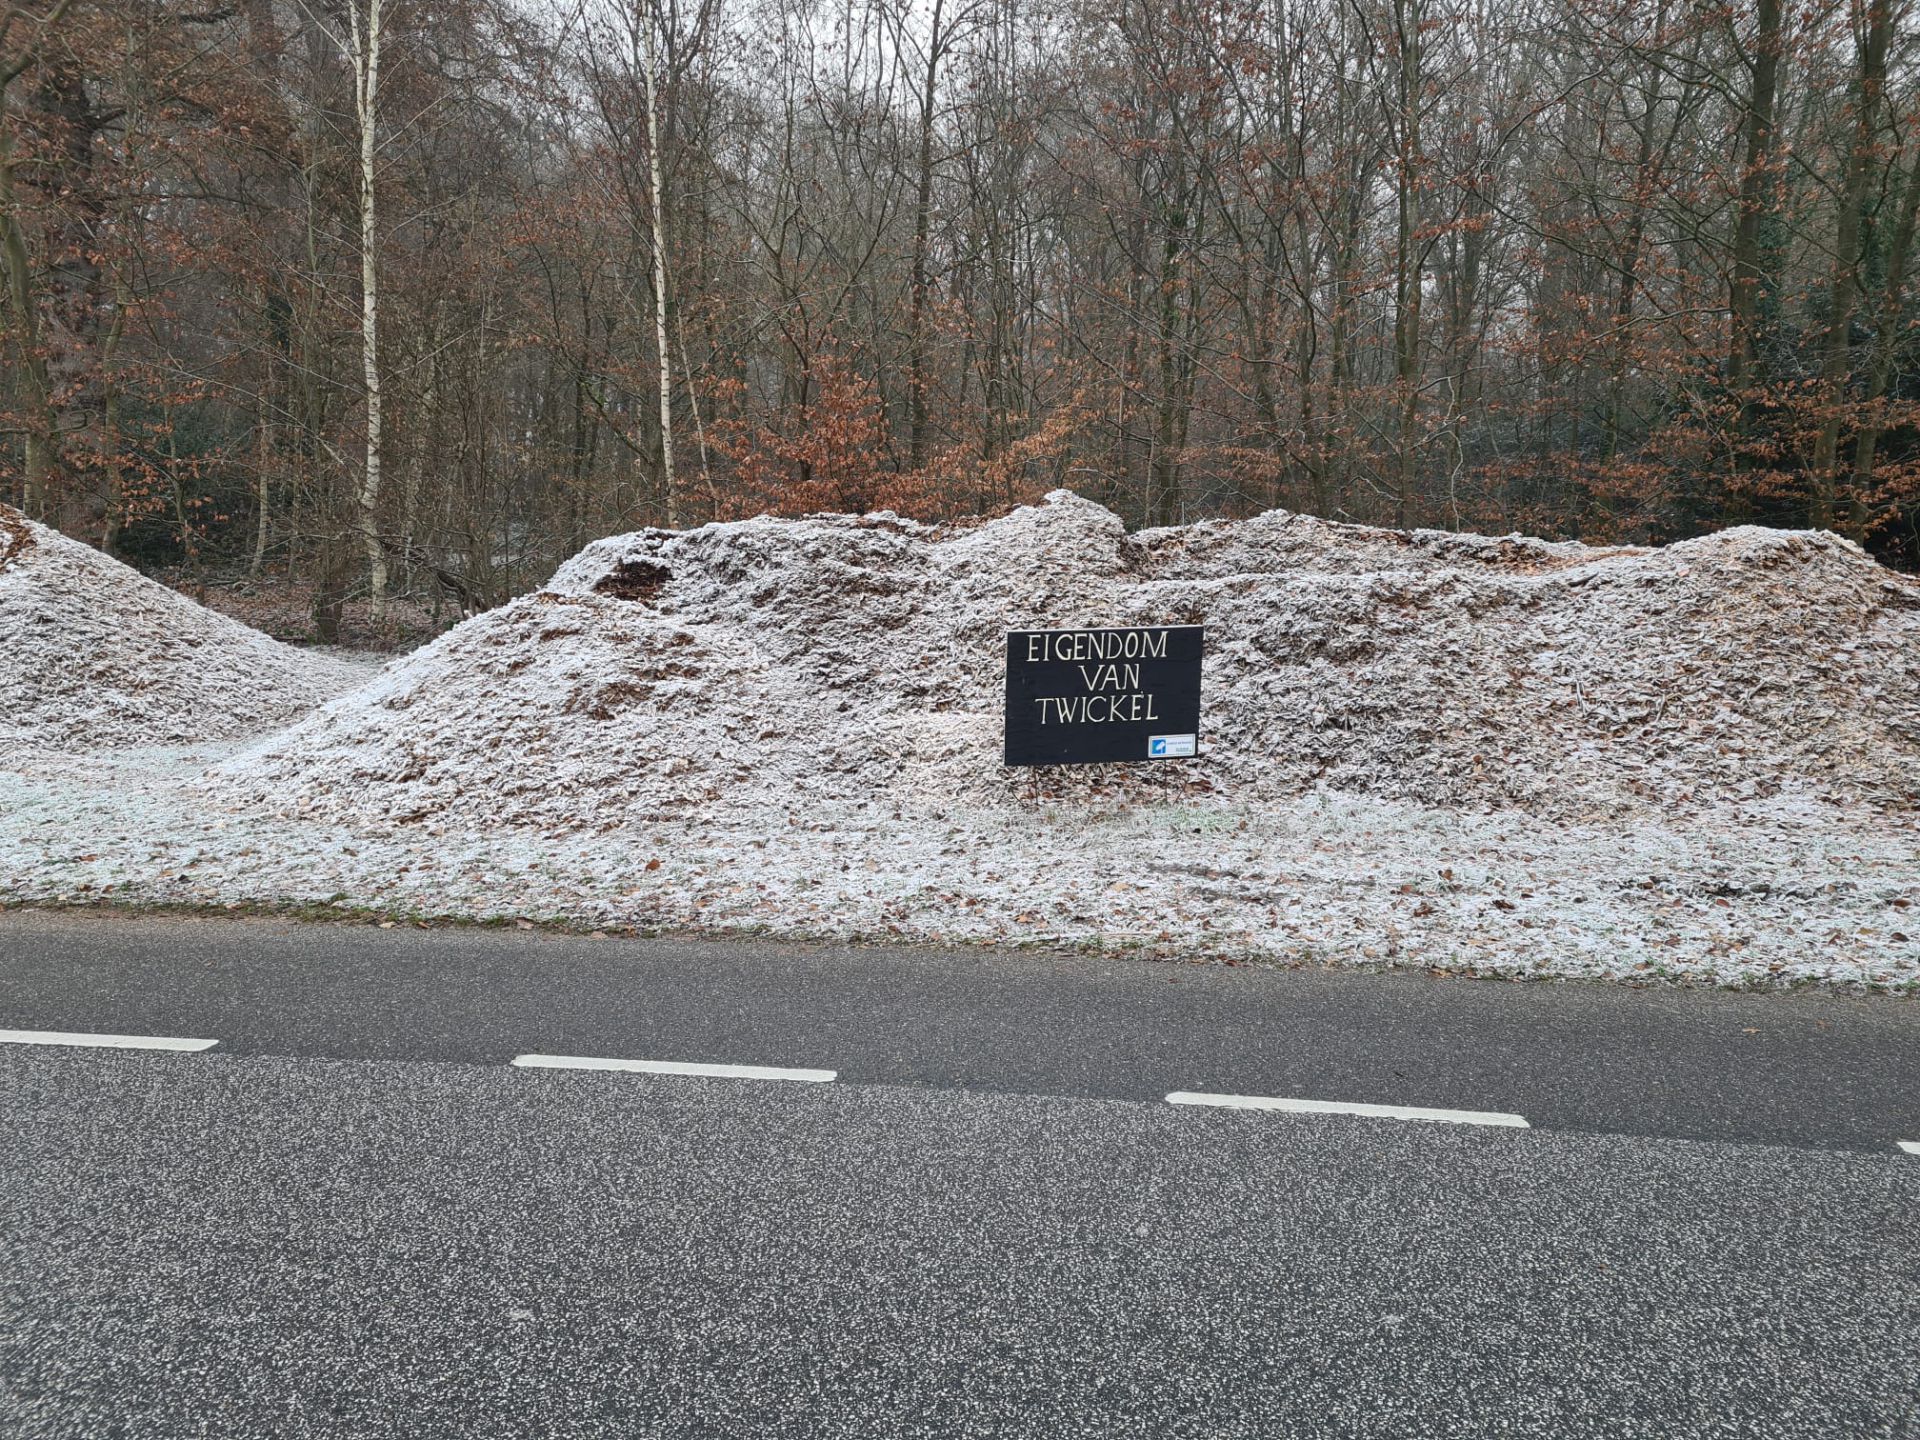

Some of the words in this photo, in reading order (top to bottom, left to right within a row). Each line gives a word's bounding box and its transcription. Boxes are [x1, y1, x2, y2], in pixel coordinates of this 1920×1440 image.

[1026, 631, 1169, 662] EIGENDOM
[1078, 663, 1140, 691] VAN
[1034, 694, 1159, 725] TWICKEL
